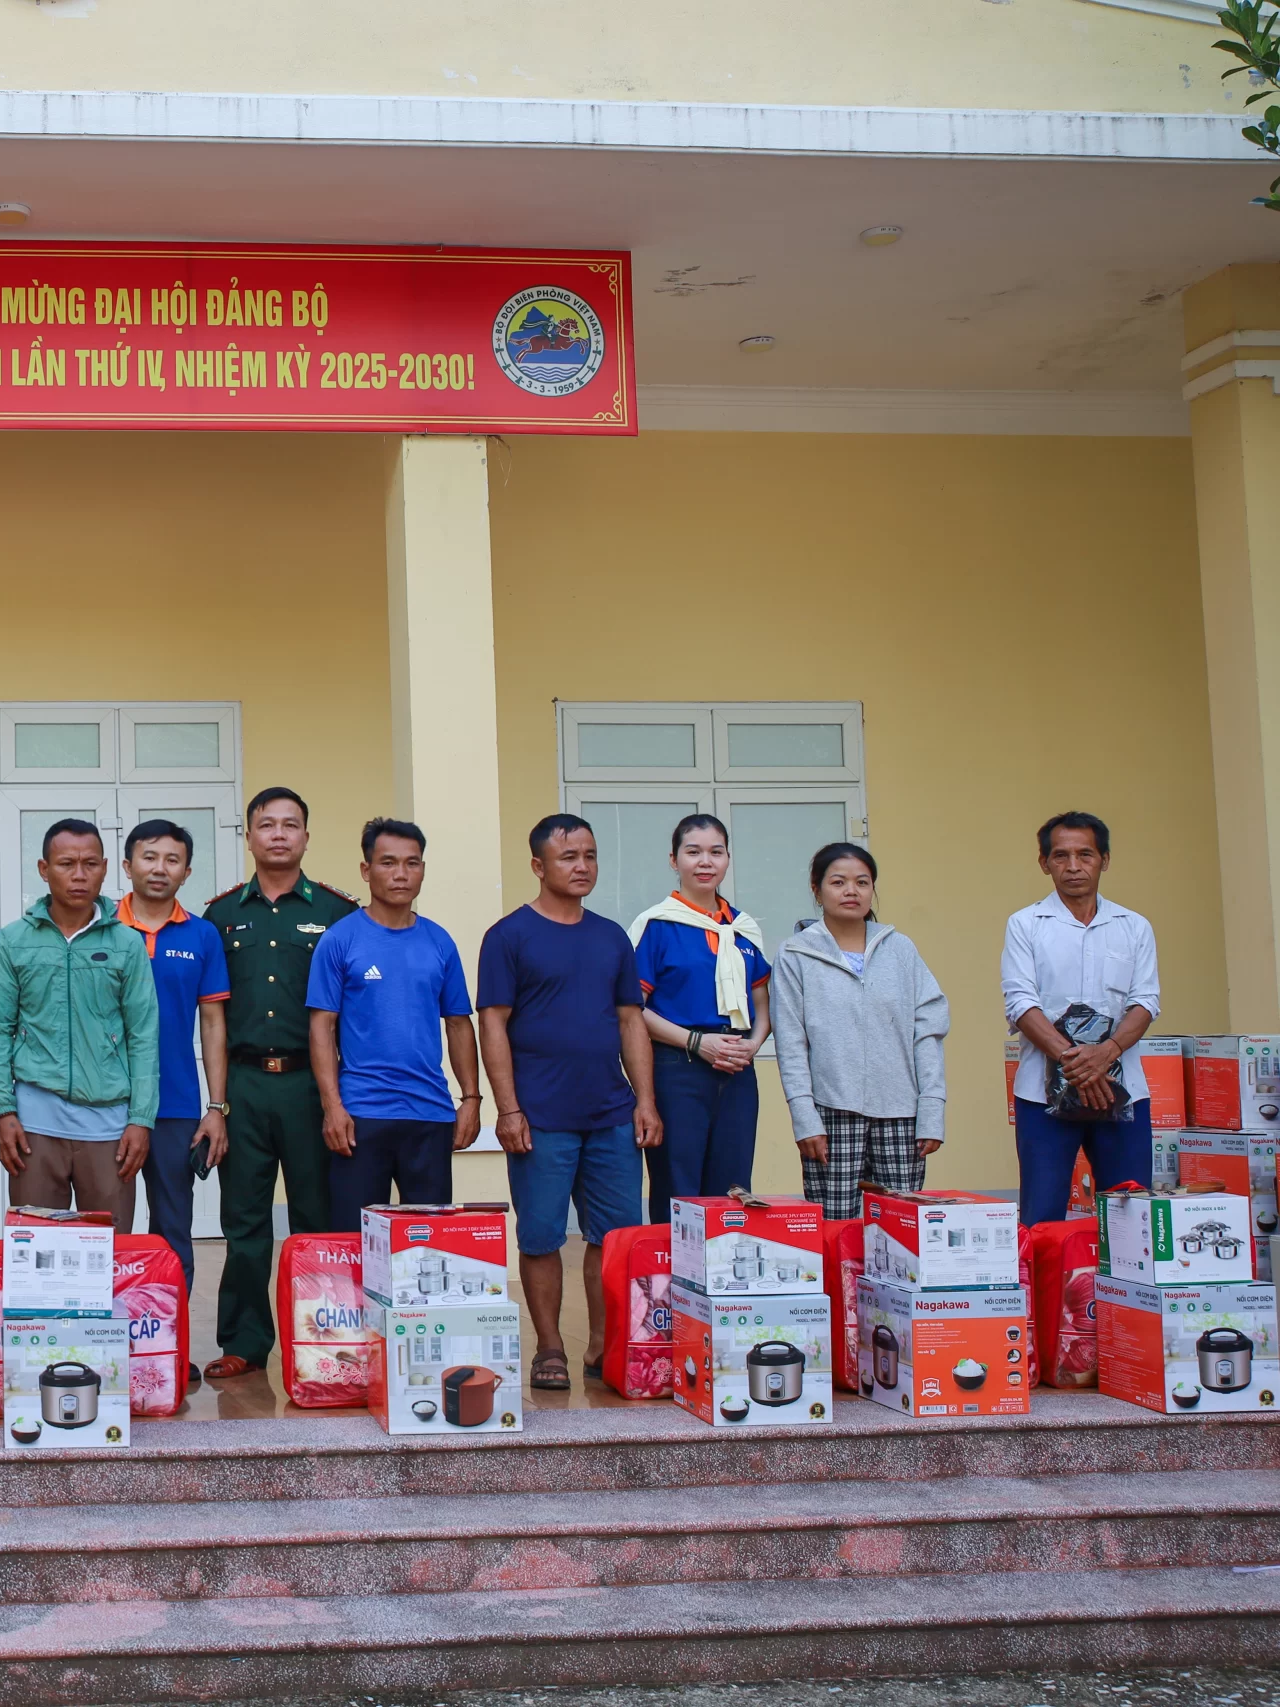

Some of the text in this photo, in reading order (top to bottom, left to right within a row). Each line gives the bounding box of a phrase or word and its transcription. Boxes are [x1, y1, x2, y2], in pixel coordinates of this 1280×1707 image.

[1, 279, 86, 325] MỪNG
[94, 287, 141, 334] ĐẠI
[152, 280, 197, 334] HỘI
[206, 276, 283, 327] ĐẢNG
[292, 282, 329, 336] BỘ
[496, 289, 601, 336] BỘ ĐỘI BIÊN PHÒNG VIỆT NAM
[11, 335, 66, 387] LẦN
[74, 340, 132, 387] THỨ
[137, 350, 167, 392] IV,
[175, 342, 267, 397] NHIỆM
[276, 343, 312, 389] KỲ
[320, 352, 475, 391] 2025-2030!
[554, 383, 574, 394] 1959
[166, 950, 194, 960] STAKA
[1180, 1138, 1212, 1148] Nagakawa
[316, 1248, 362, 1265] THÀN
[113, 1261, 146, 1278] ÔNG
[1096, 1282, 1127, 1297] Nagakawa
[1164, 1292, 1200, 1300] Nagakawa
[916, 1300, 970, 1312] Nagakawa
[315, 1303, 361, 1329] CHĂN
[7, 1324, 45, 1332] Nagakawa
[128, 1310, 161, 1341] CẤP
